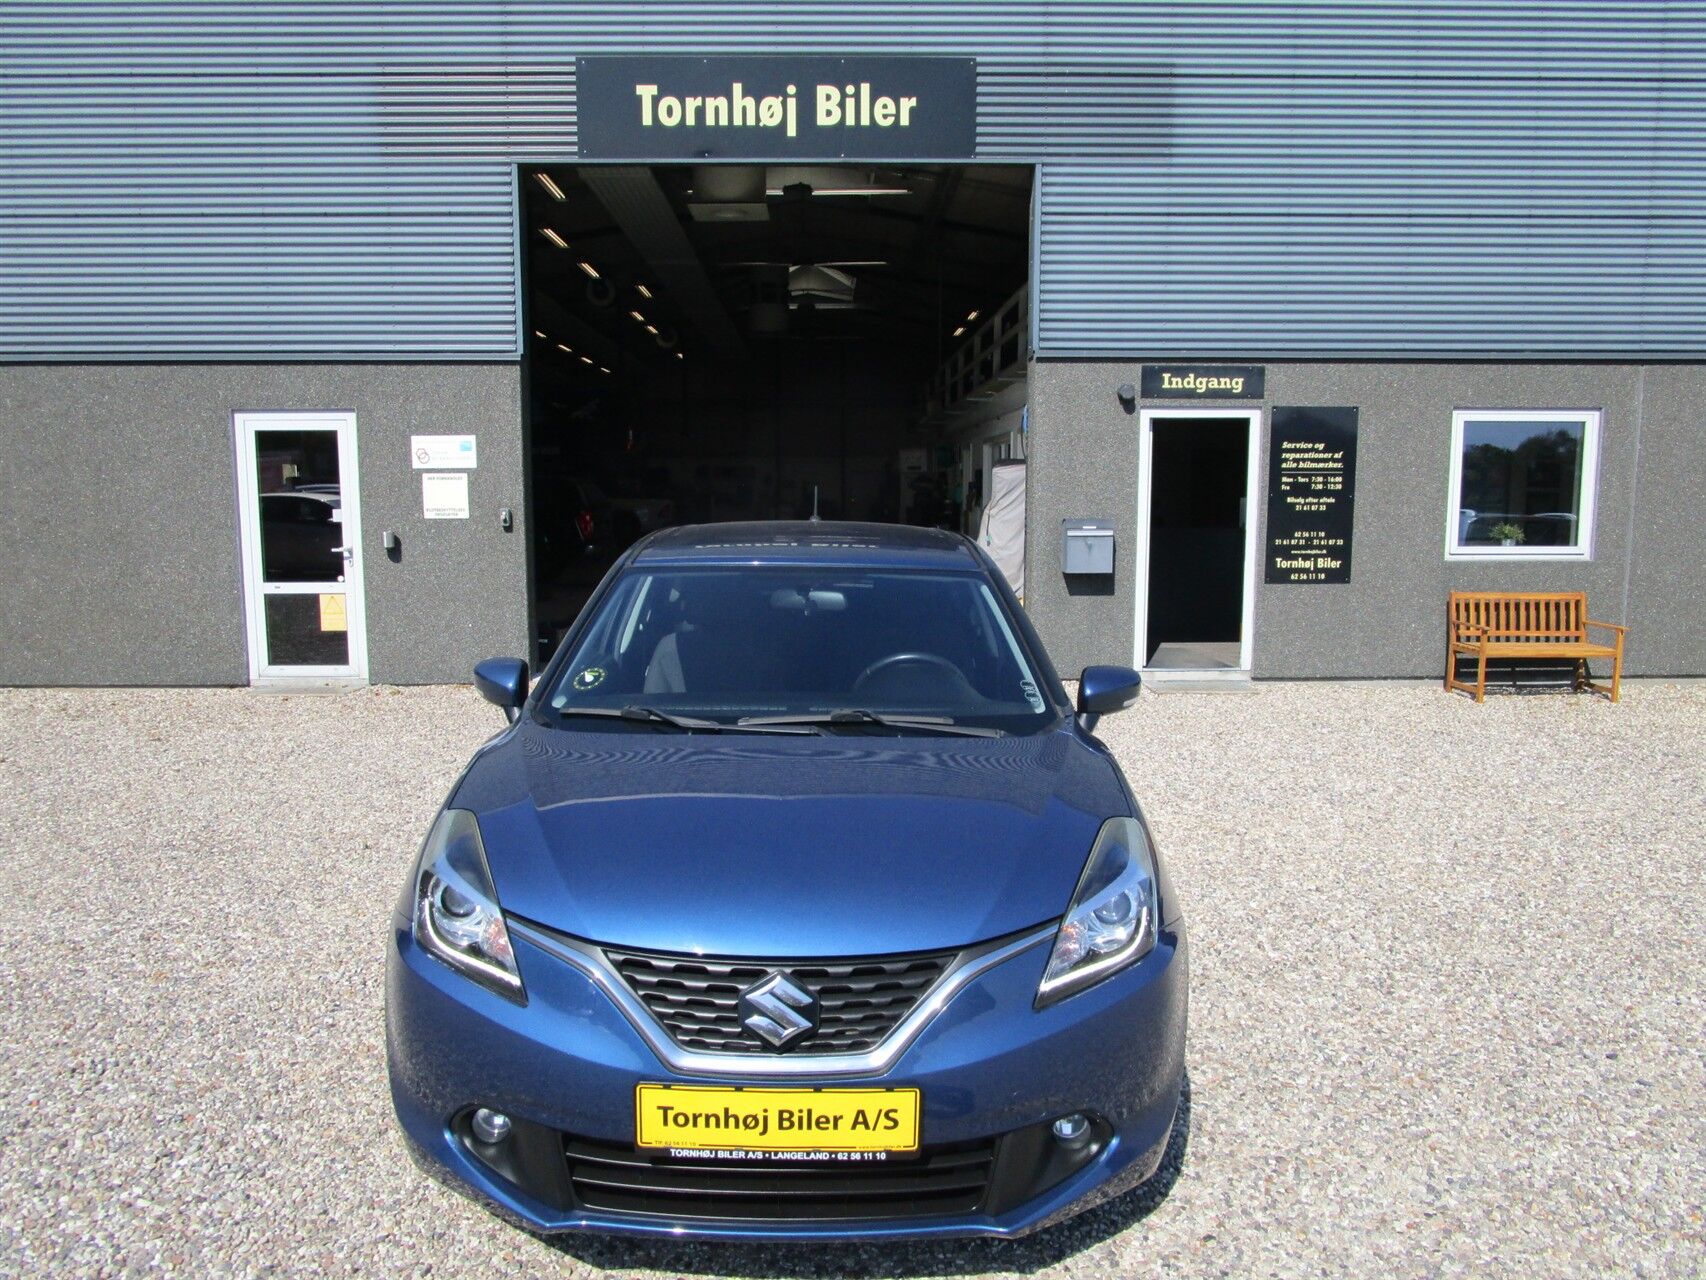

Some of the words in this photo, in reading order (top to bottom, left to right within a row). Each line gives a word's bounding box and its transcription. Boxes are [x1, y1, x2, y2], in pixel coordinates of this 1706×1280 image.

[636, 82, 797, 137] Tornhøj
[816, 82, 917, 127] Biler
[1162, 373, 1244, 393] Indgang
[1281, 441, 1313, 449] Service
[1281, 451, 1333, 460] reparationer
[1333, 451, 1343, 459] af
[1275, 557, 1314, 571] Tornhøj
[1317, 557, 1342, 569] Biler
[656, 1105, 769, 1136] Tornhøj
[777, 1108, 844, 1131] Biler
[850, 1108, 900, 1132] A/S
[670, 1148, 716, 1159] TORNHØJ
[717, 1149, 746, 1159] BILER
[747, 1150, 764, 1160] A/S
[771, 1151, 830, 1160] LANGELAND
[837, 1151, 850, 1160] 62
[850, 1151, 862, 1160] 56
[863, 1151, 873, 1160] 11
[875, 1151, 887, 1160] 10
